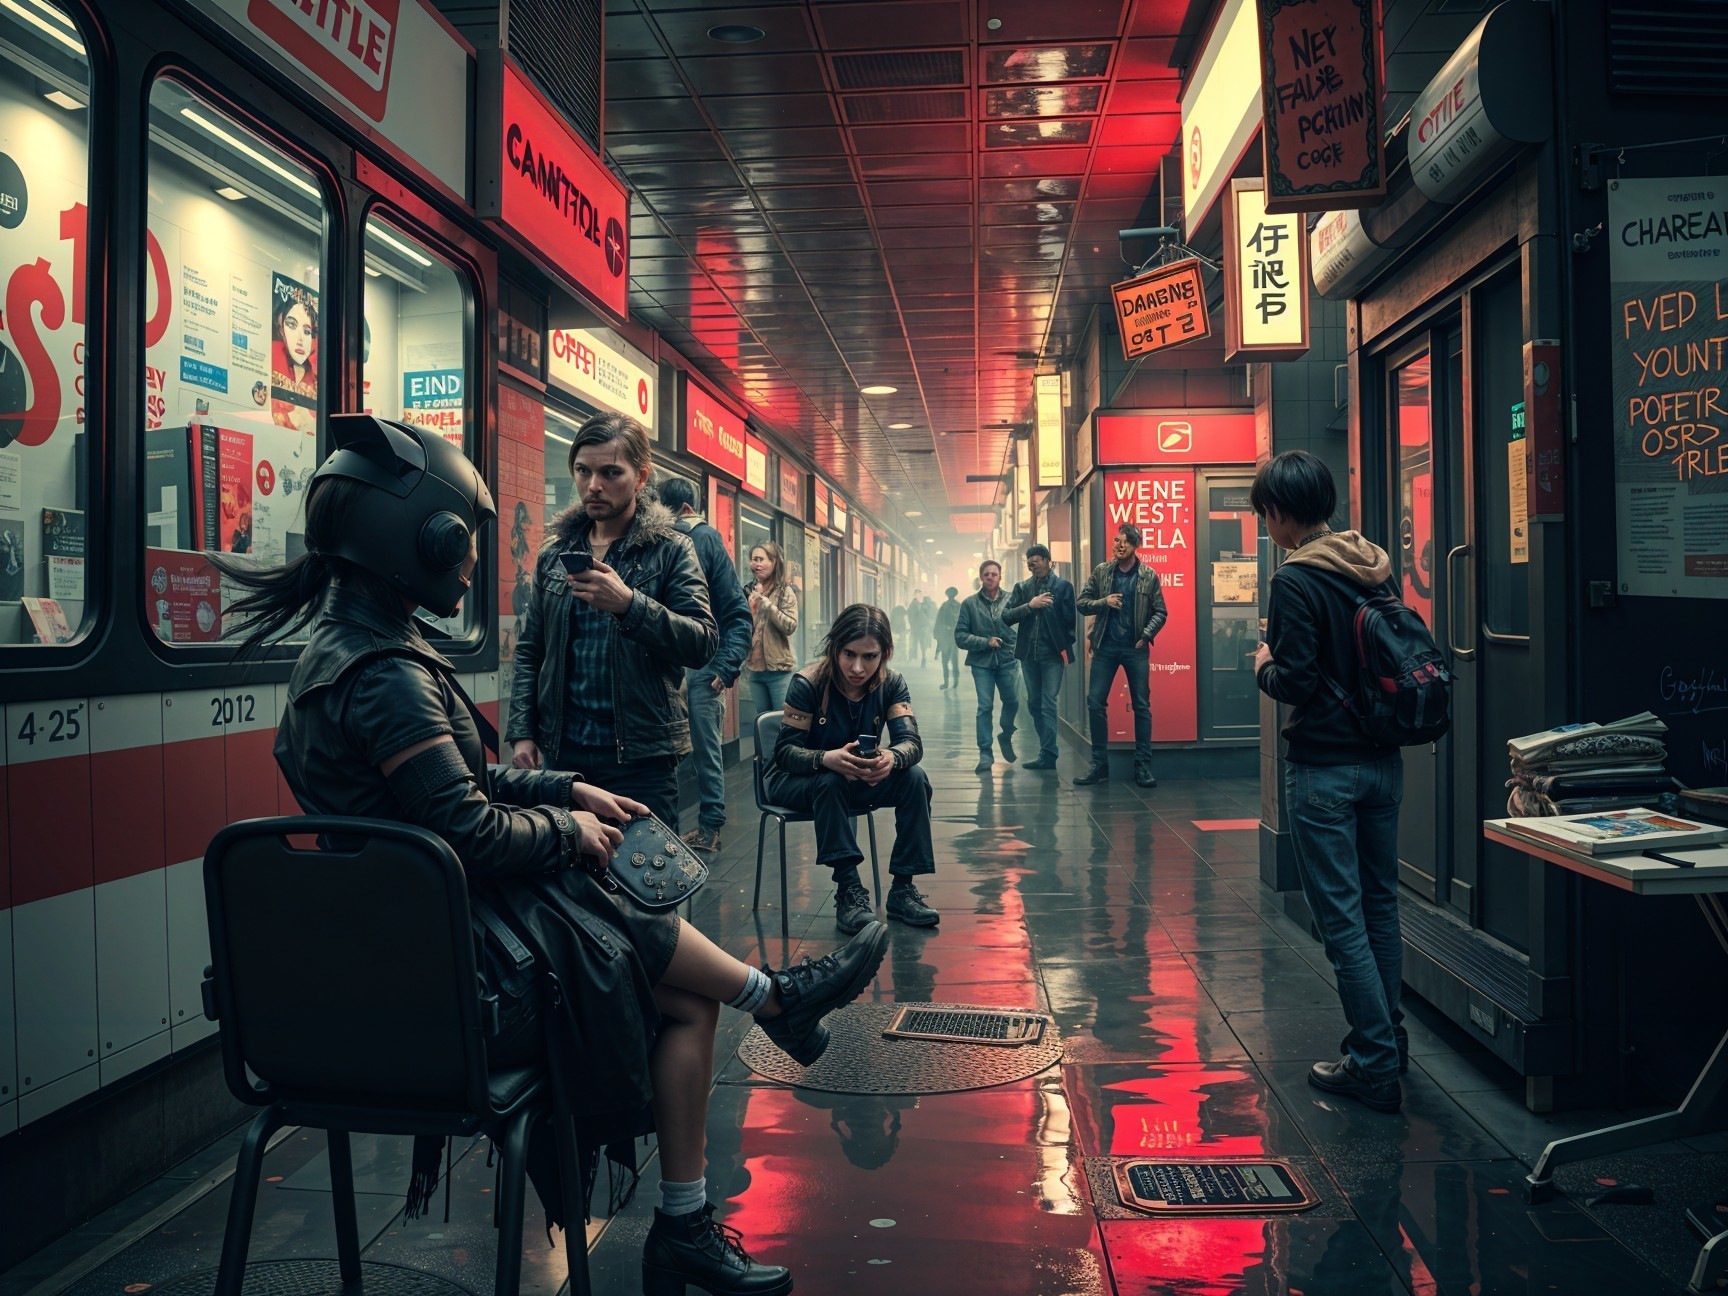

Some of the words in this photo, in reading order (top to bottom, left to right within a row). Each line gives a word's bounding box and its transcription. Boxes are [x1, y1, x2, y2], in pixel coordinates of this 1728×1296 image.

[1113, 480, 1186, 500] WENE
[1141, 528, 1187, 549] ELA
[211, 694, 256, 727] 2012
